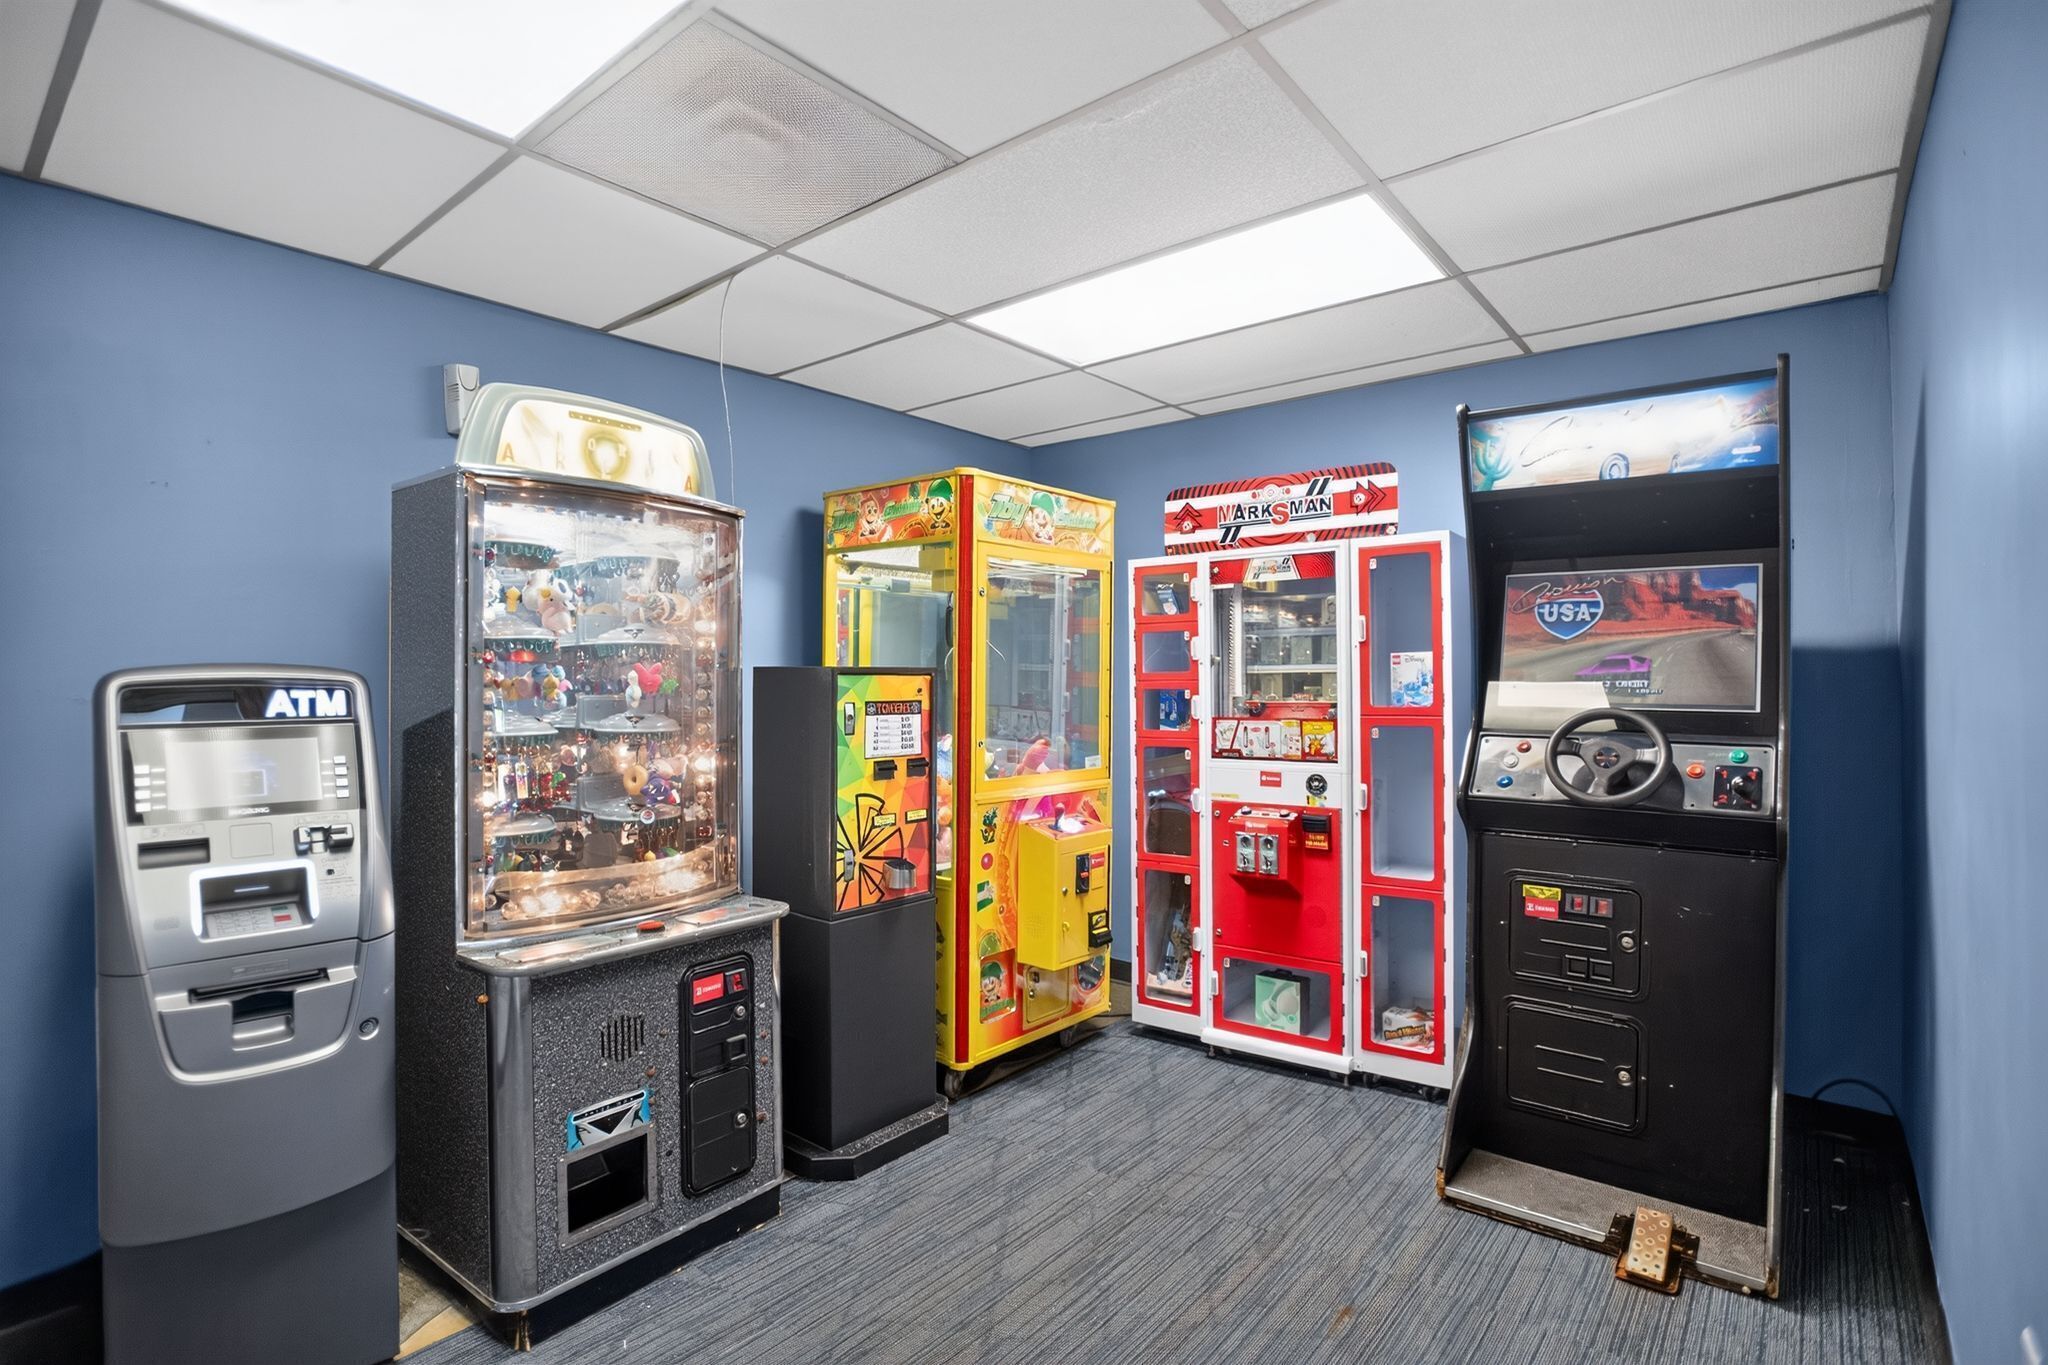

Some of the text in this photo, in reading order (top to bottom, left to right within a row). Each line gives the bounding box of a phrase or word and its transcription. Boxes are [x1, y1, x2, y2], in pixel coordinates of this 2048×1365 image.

[1218, 496, 1332, 526] MARKSMAN
[1543, 602, 1592, 623] USA
[264, 688, 347, 718] ATM
